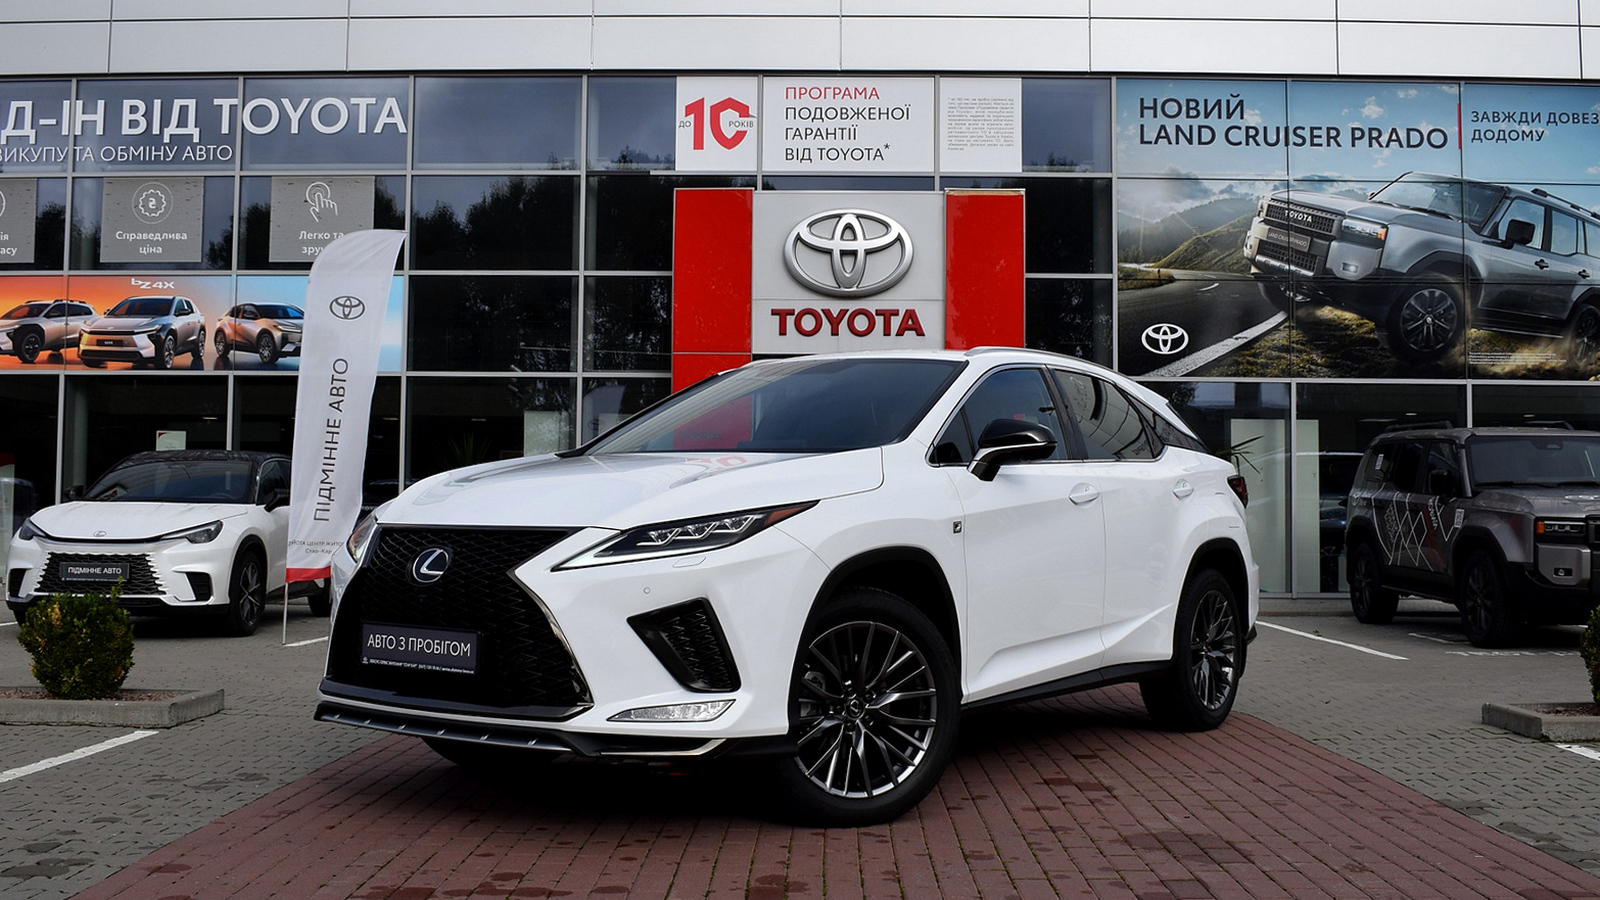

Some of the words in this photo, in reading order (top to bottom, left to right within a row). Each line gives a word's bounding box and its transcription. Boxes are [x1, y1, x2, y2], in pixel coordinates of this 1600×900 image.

[785, 86, 880, 100] ПРОГРАМА
[785, 103, 912, 123] ПОДОВЖЕНОЇ
[1139, 93, 1245, 120] НОВИЙ
[122, 98, 200, 143] ВІД
[213, 97, 407, 134] TOYOTA
[678, 120, 692, 129] ДО
[728, 120, 755, 128] РОКІВ
[1471, 110, 1542, 126] ЗАВЖДИ
[785, 123, 859, 141] ГАРАНТІЇ
[1139, 124, 1217, 146] LAND
[1223, 125, 1343, 148] CRUISER
[1350, 126, 1449, 150] PRADO
[1471, 129, 1545, 144] ДОДОМУ
[74, 147, 95, 162] ТА
[100, 145, 177, 162] ОБМІНУ
[182, 145, 233, 162] АВТО
[785, 147, 813, 163] ВІД
[1285, 210, 1312, 223] TOYOTA
[115, 230, 188, 242] Справедлива
[298, 230, 331, 240] Легко
[139, 244, 163, 255] ціна
[771, 308, 925, 337] TOYOTA
[313, 417, 343, 522] ПІДМІННЕ
[328, 357, 350, 413] АВТО
[67, 567, 102, 575] ПІДМІННЕ
[102, 567, 122, 575] АВТО
[367, 634, 397, 650] АВТО
[398, 637, 406, 650] З
[408, 638, 471, 657] ПРОБІГОМ
